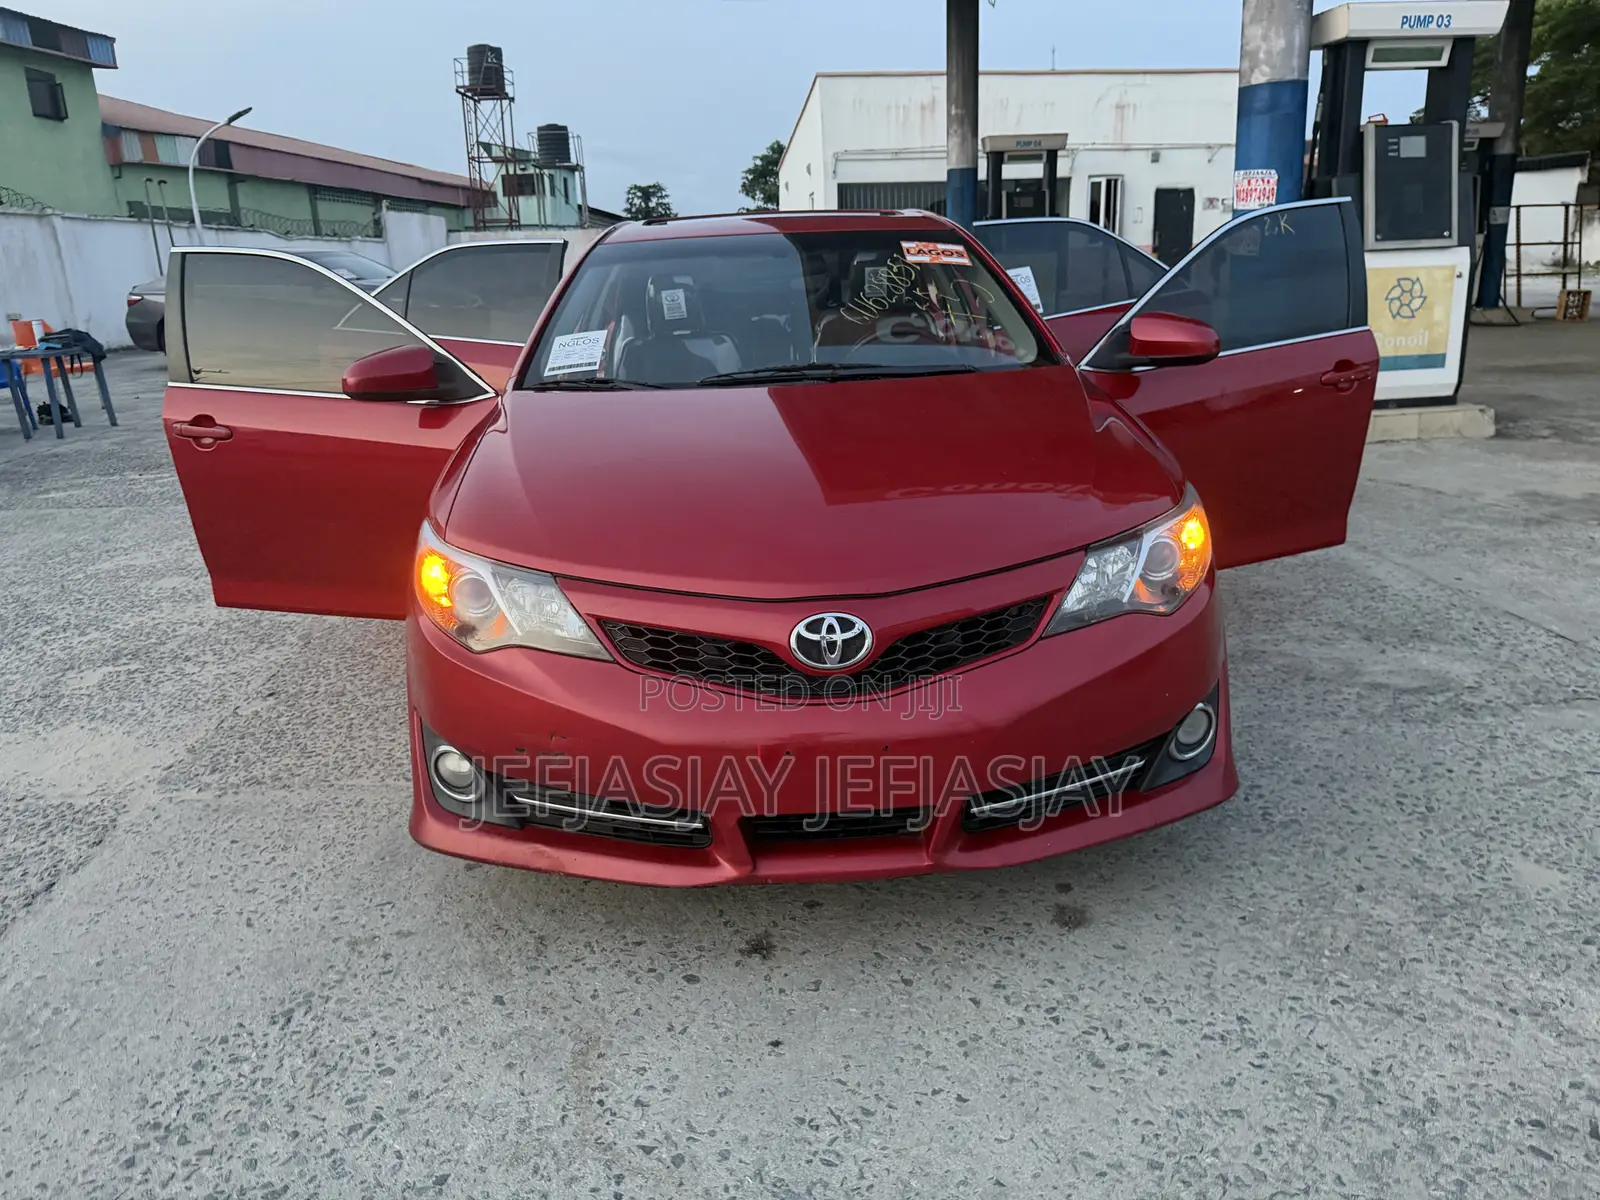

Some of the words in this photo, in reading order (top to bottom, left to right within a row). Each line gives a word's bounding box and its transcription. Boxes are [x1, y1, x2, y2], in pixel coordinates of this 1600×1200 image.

[1401, 14, 1435, 29] PUMP
[1436, 13, 1452, 29] 03
[1015, 139, 1033, 148] PUMP
[905, 247, 965, 258] LAGOS
[558, 337, 600, 348] NGLOS
